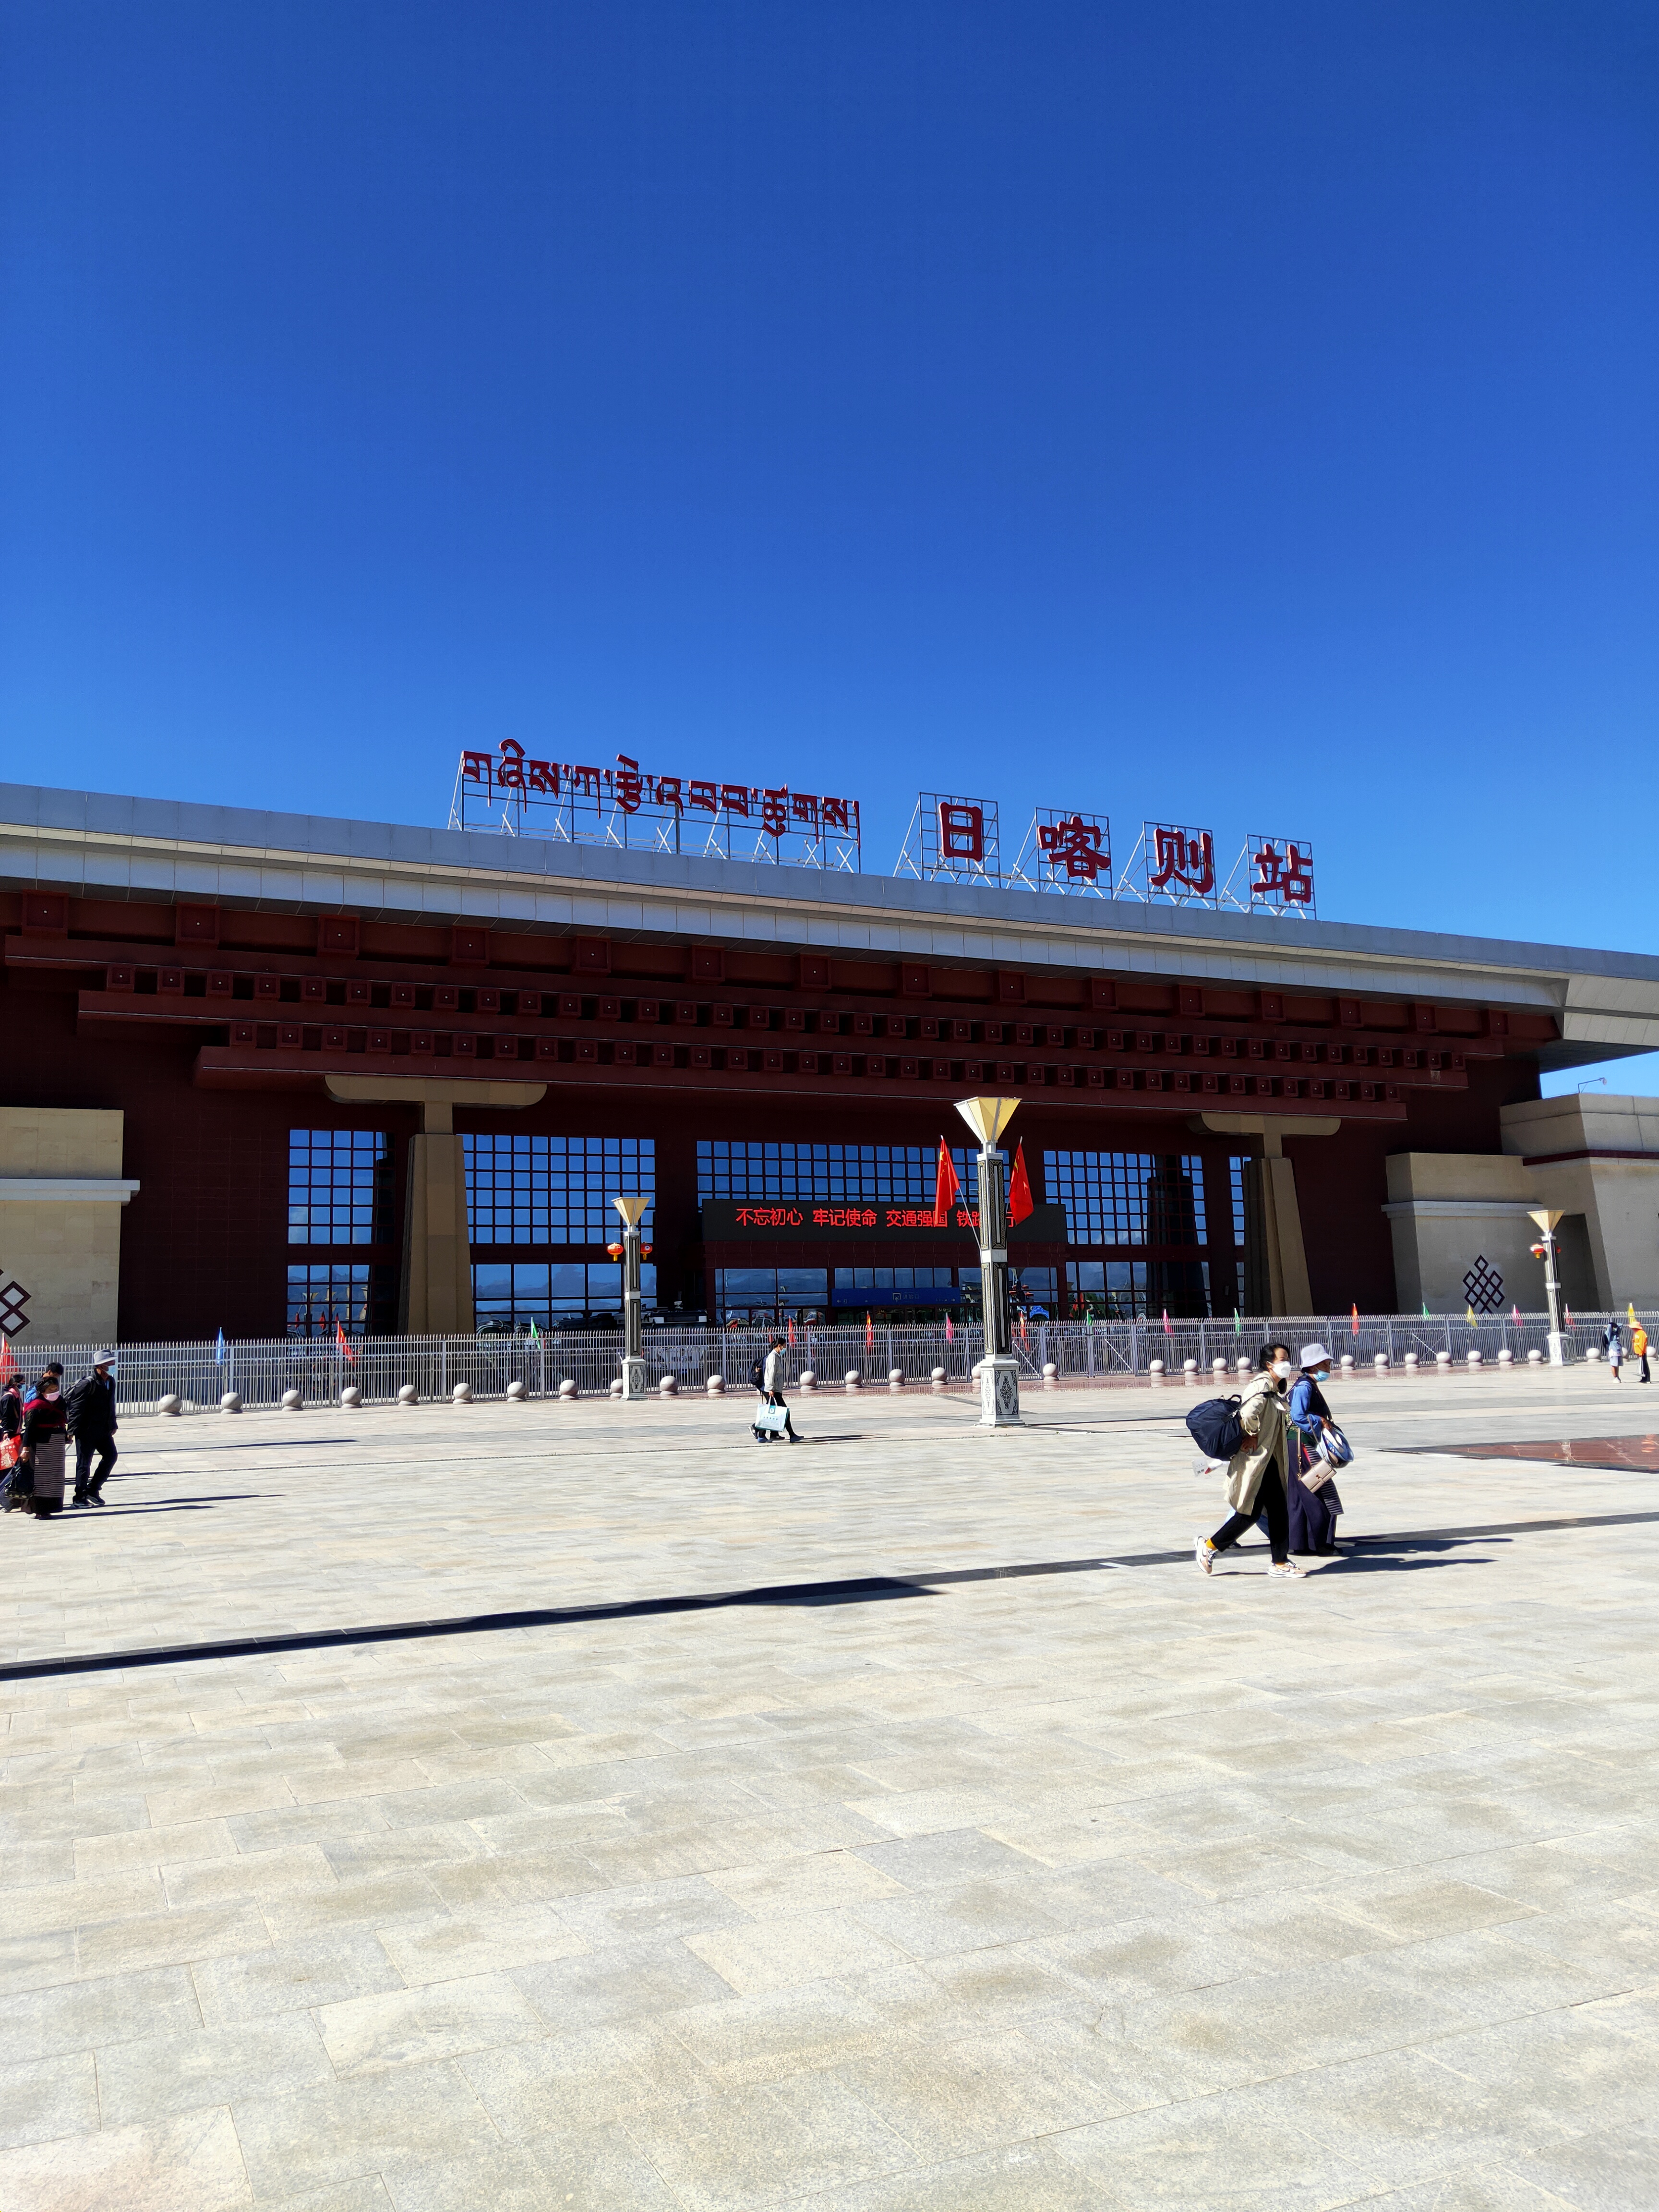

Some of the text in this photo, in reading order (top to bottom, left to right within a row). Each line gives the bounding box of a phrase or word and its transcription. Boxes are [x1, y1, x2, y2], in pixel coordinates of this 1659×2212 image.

[938, 802, 1313, 903] 日喀则站
[736, 1207, 804, 1226] 不忘初心
[813, 1208, 878, 1227] 牢记使命
[886, 1209, 948, 1228] 交通强国
